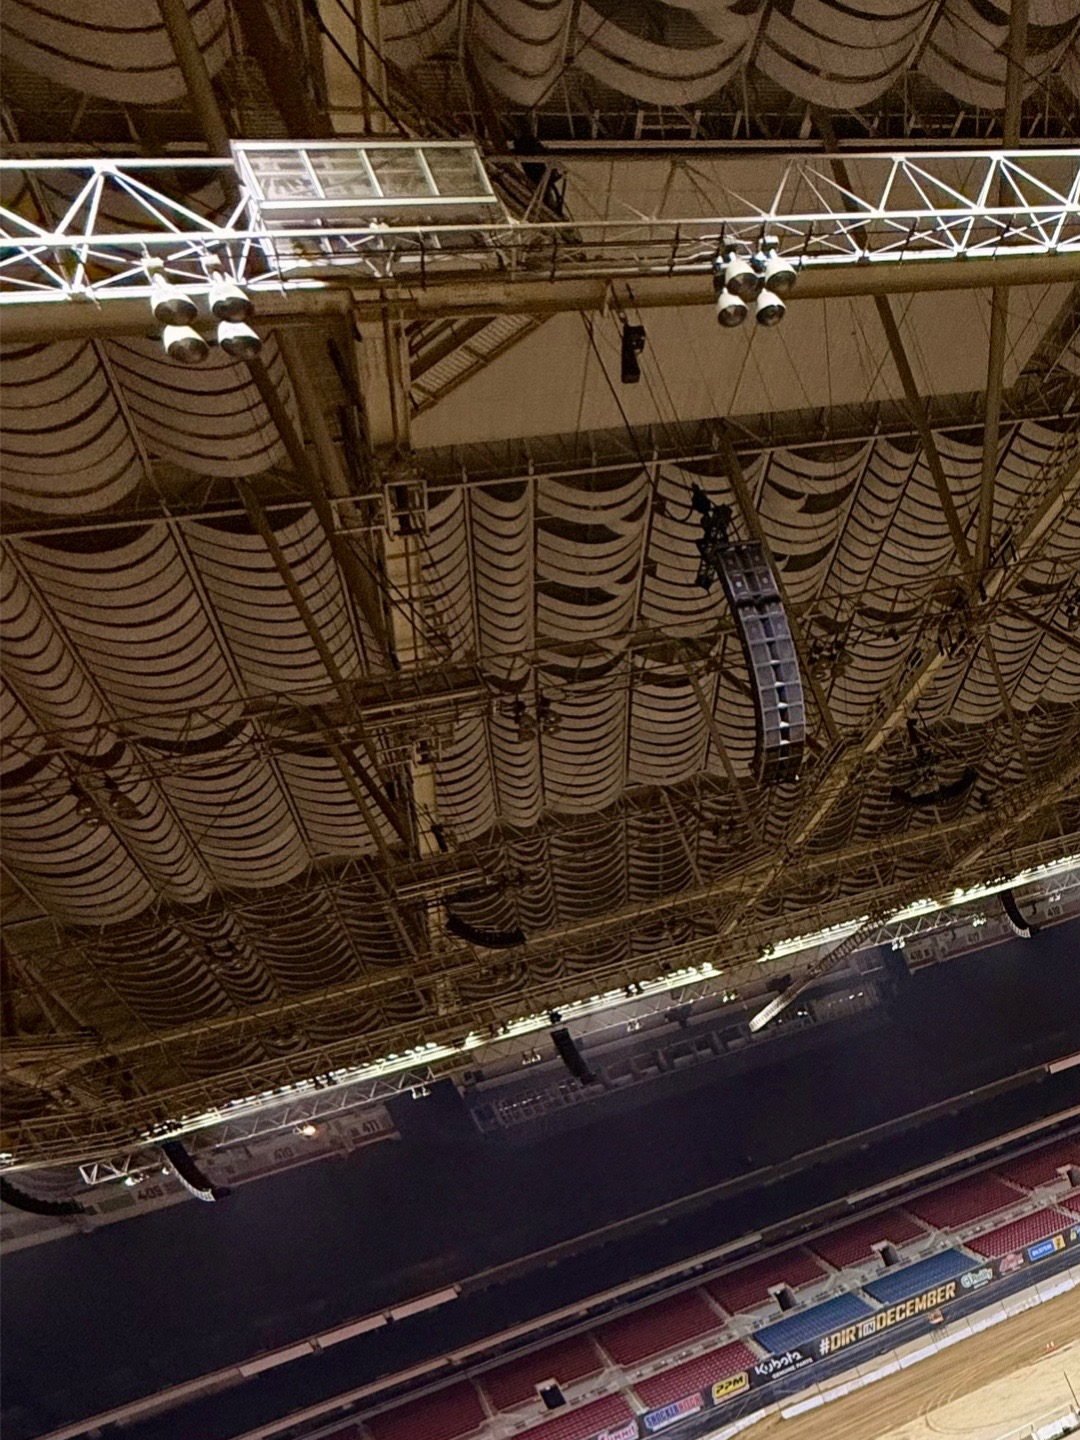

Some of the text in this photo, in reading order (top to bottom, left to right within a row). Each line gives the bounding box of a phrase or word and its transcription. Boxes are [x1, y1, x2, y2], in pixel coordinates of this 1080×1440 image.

[361, 1118, 381, 1134] 411
[273, 1145, 294, 1160] 410
[136, 1185, 164, 1200] 409
[754, 1351, 802, 1376] Kubota
